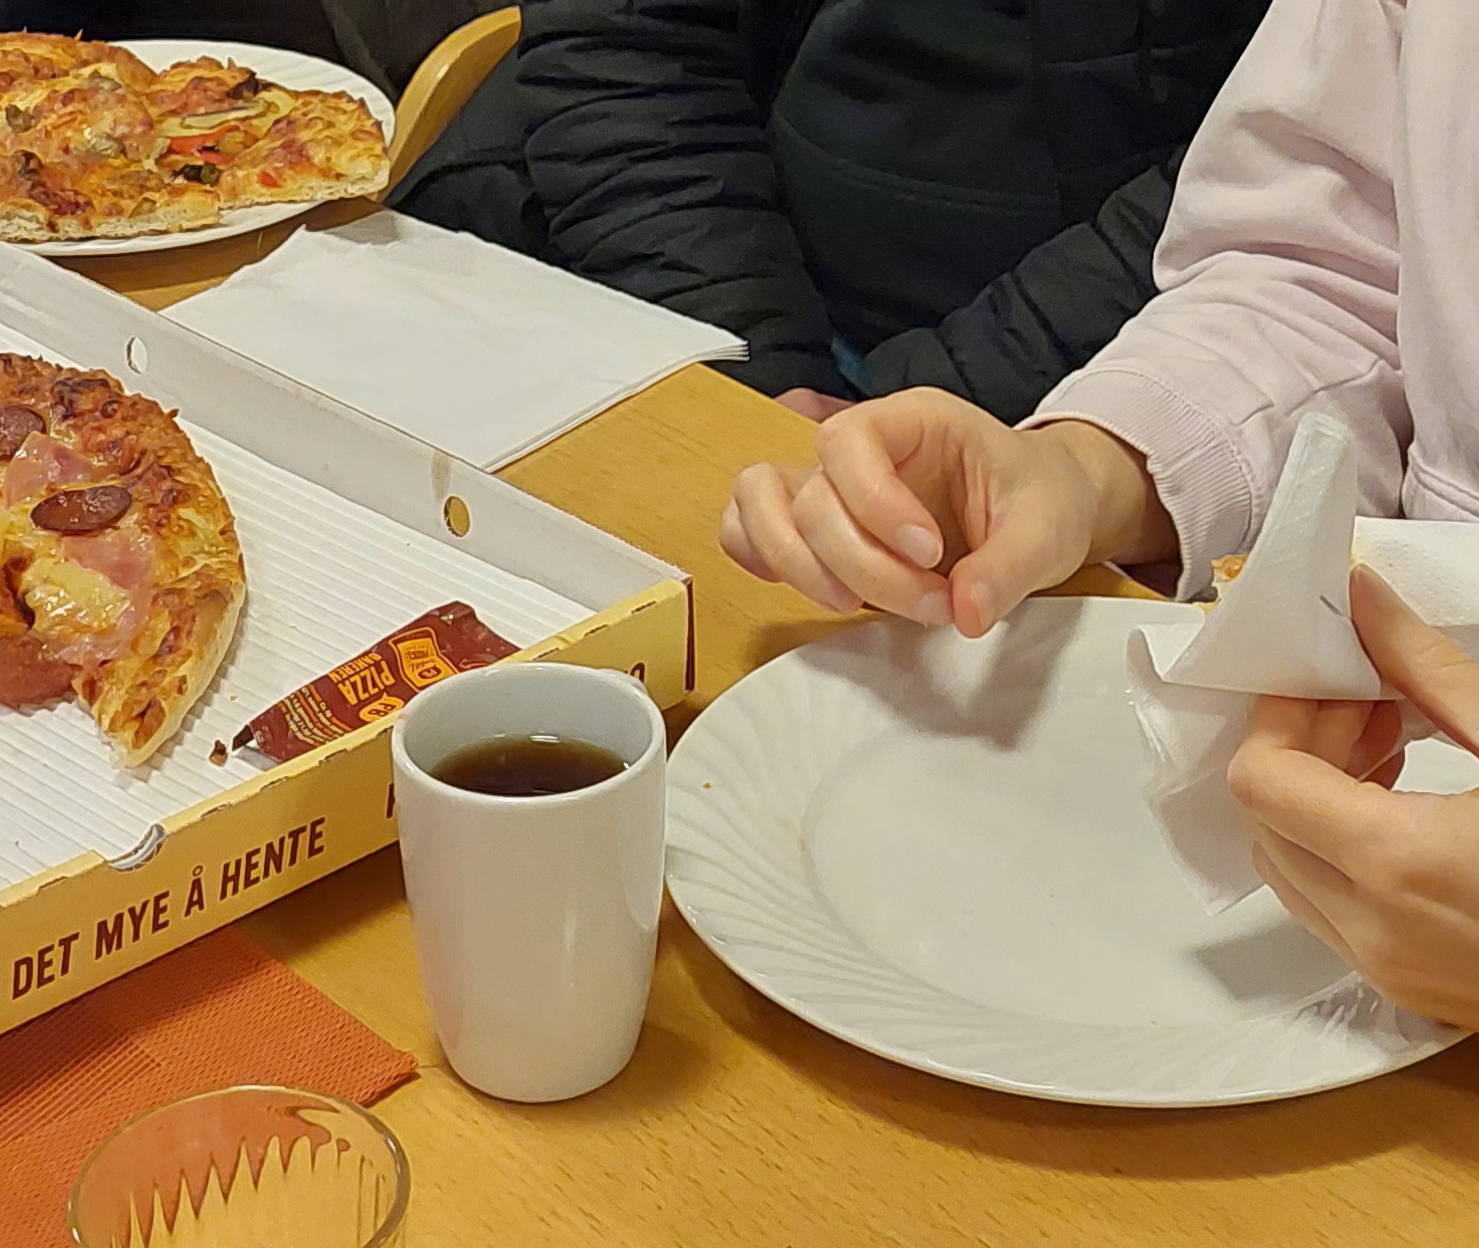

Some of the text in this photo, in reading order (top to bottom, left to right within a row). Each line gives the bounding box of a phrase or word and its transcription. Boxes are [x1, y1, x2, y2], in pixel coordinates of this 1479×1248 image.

[337, 659, 396, 707] PIZZA
[11, 931, 81, 1001] DET
[94, 890, 171, 961] MYE
[184, 864, 205, 918] Å
[219, 817, 326, 902] HENTE
